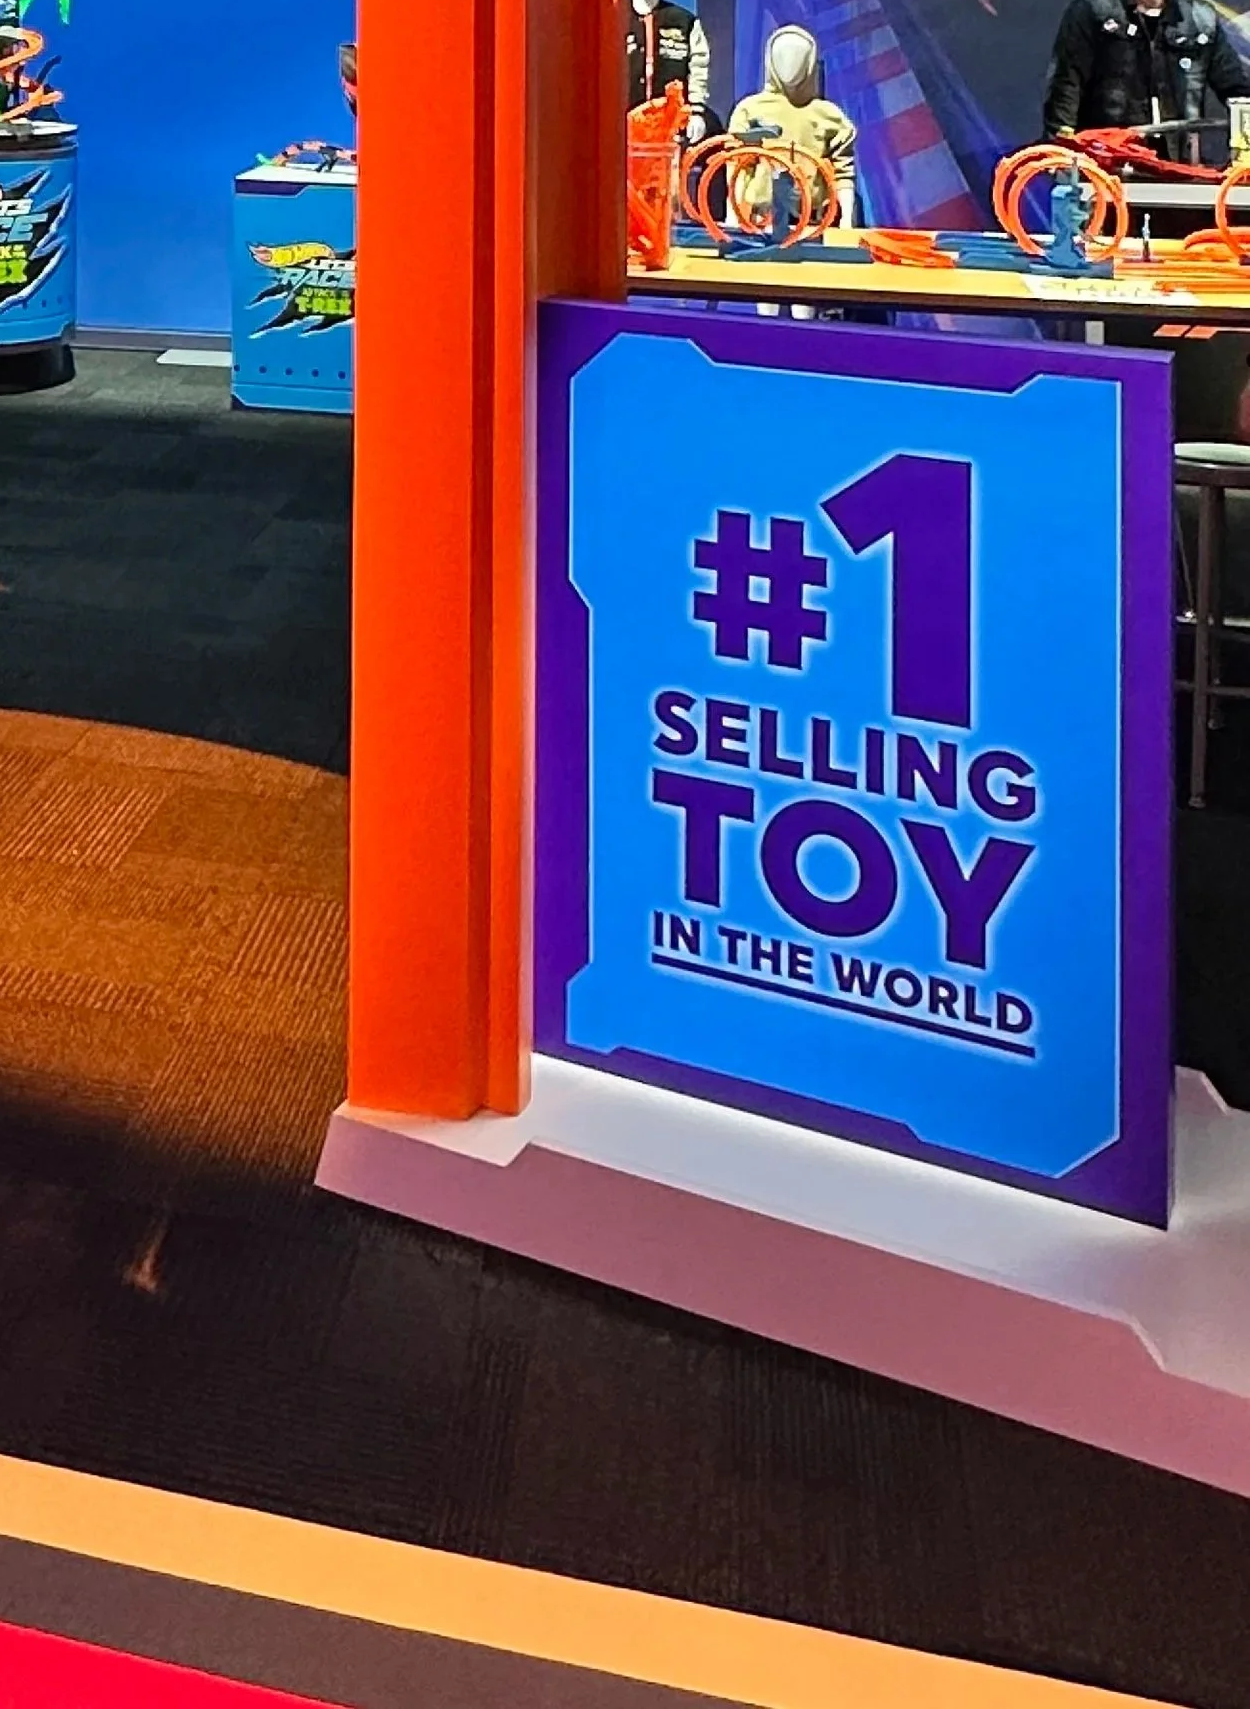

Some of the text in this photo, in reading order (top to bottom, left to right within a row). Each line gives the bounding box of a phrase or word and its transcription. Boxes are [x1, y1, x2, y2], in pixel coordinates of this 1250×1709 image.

[692, 453, 972, 729] #1
[652, 690, 1037, 822] SELLING
[652, 767, 1037, 970] TOY
[653, 910, 1033, 1035] IN THE WORLD
